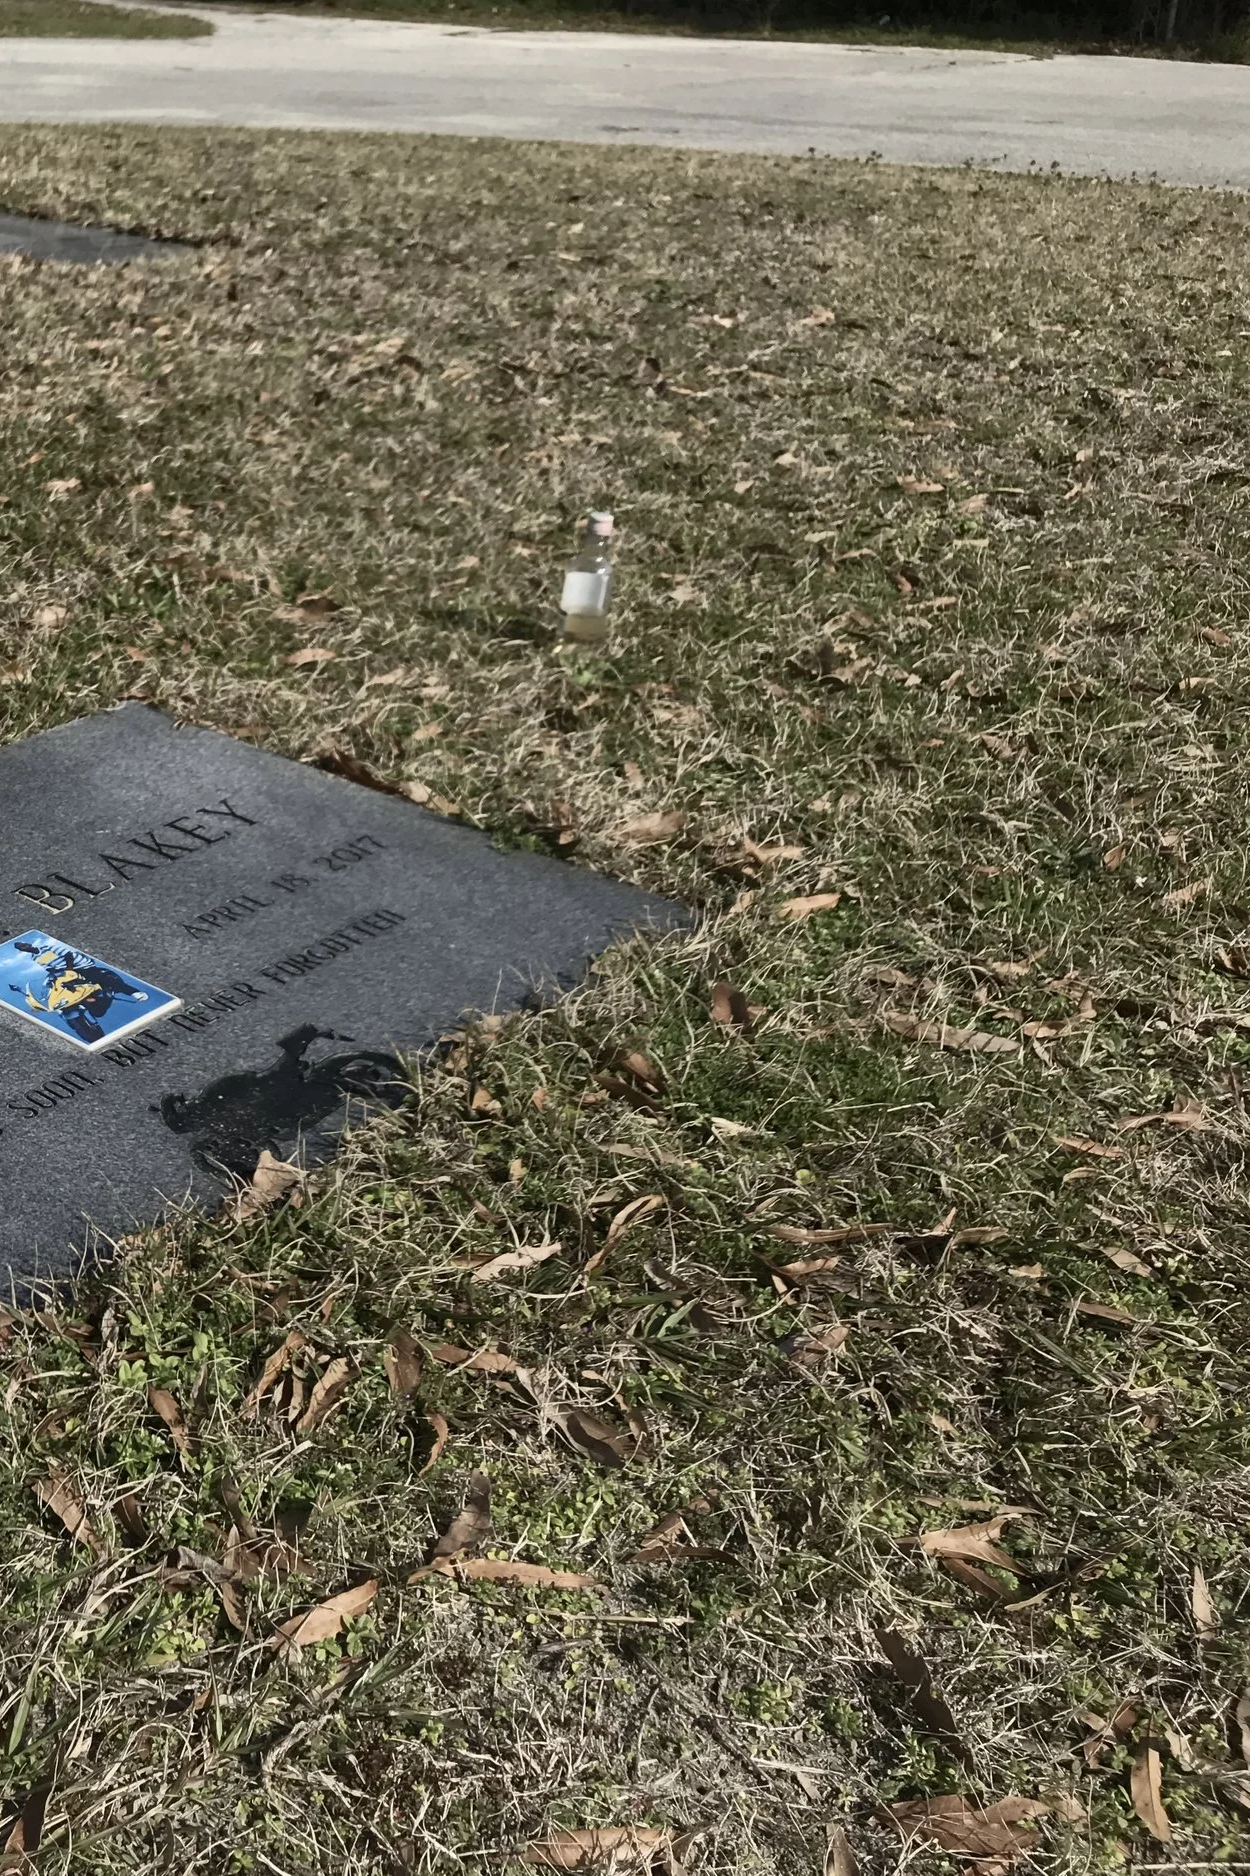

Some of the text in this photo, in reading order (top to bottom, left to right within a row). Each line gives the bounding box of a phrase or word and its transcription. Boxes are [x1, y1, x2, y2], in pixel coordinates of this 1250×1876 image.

[11, 799, 259, 915] BLAKEY
[181, 893, 276, 940] APRIL
[312, 834, 389, 872] 2017
[100, 1028, 170, 1068] BUT
[167, 982, 268, 1032] NEVER
[255, 908, 407, 985] FORGOTTEN
